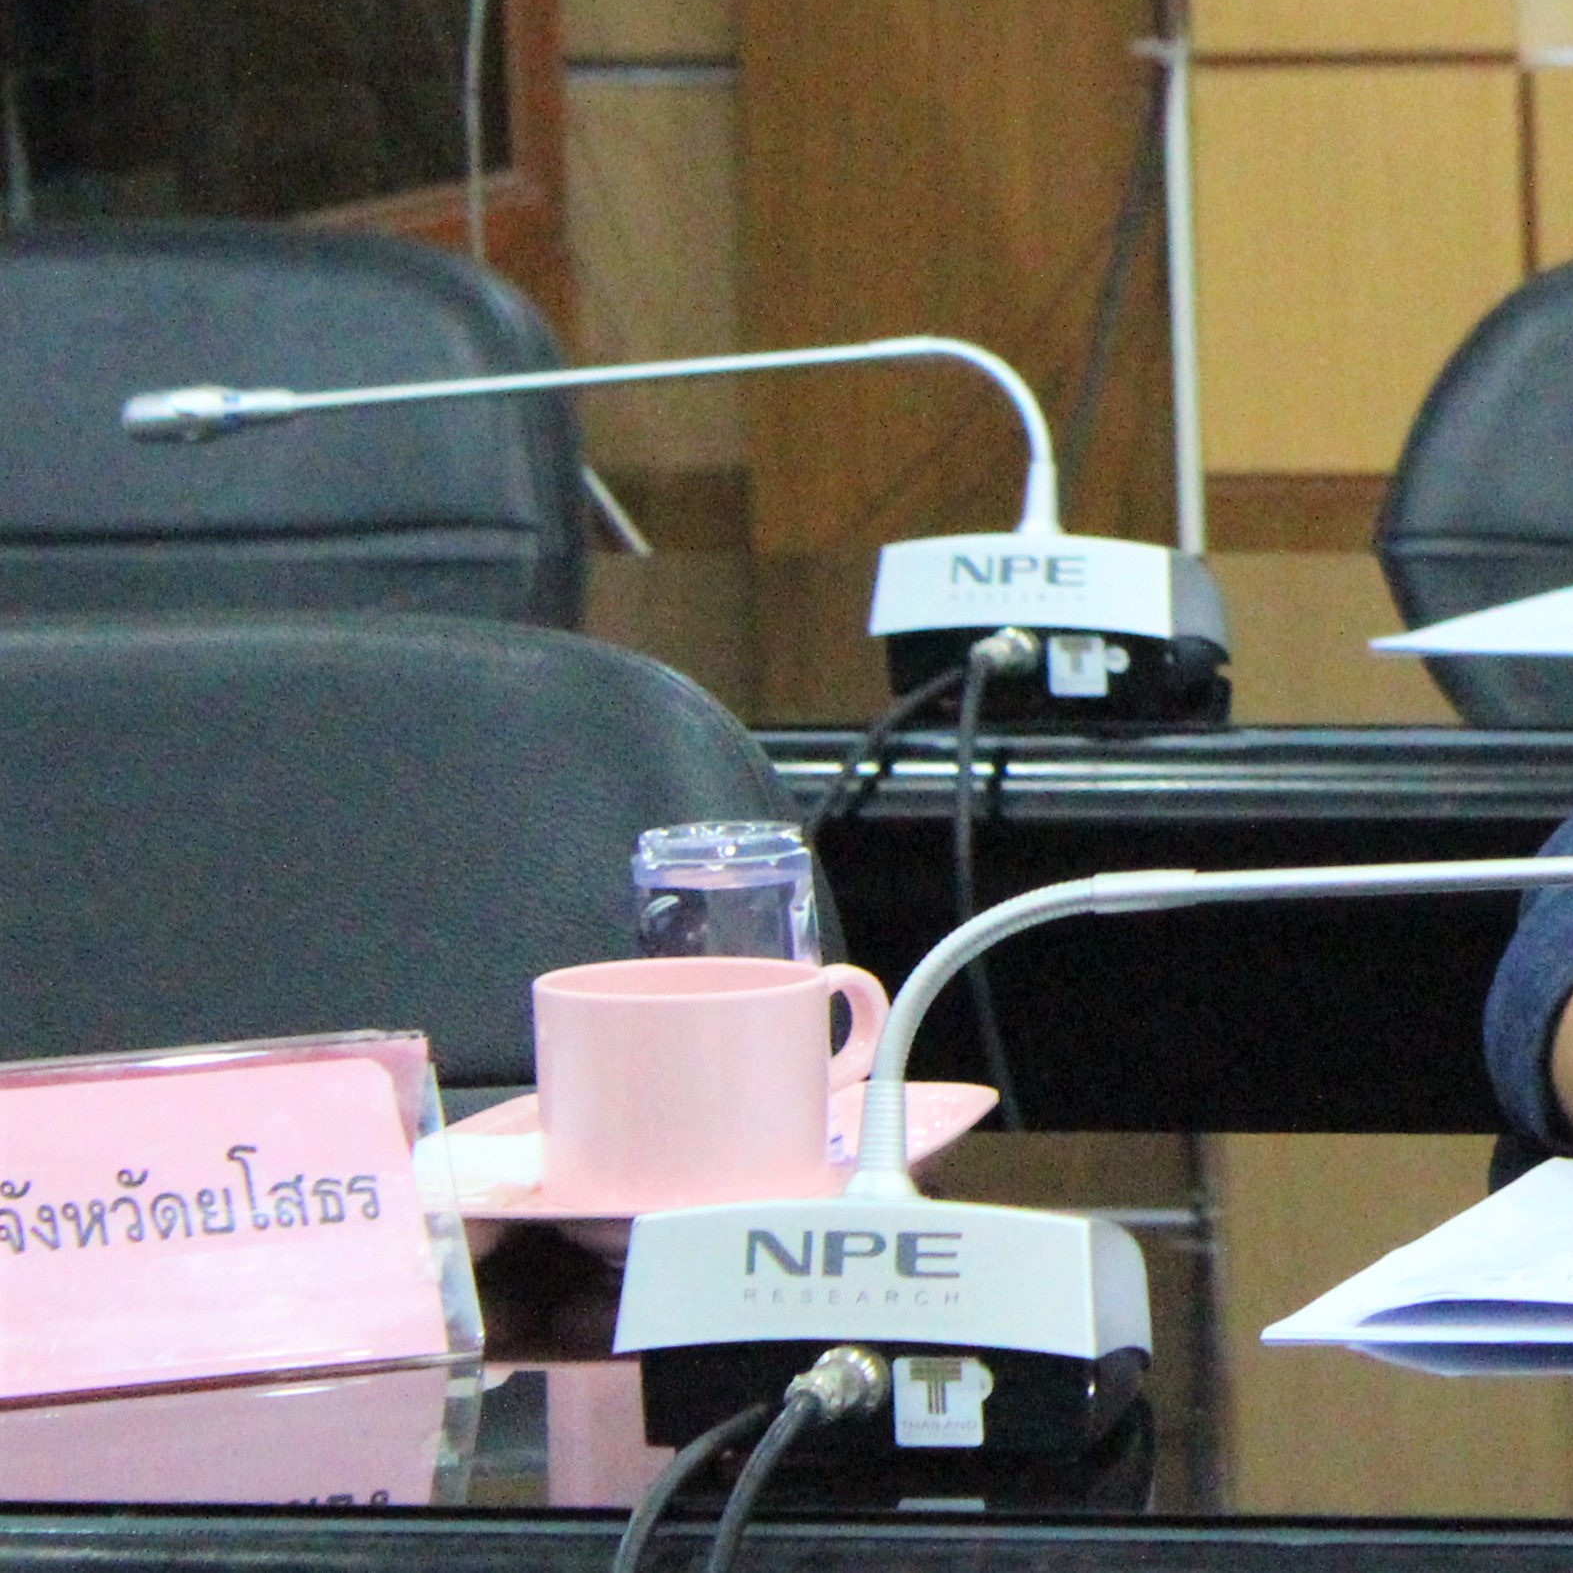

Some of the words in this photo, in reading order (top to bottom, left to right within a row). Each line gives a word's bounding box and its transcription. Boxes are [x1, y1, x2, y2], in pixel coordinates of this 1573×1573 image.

[952, 554, 1088, 587] NPE
[745, 1229, 962, 1278] NPE
[743, 1289, 960, 1306] RESEARCH
